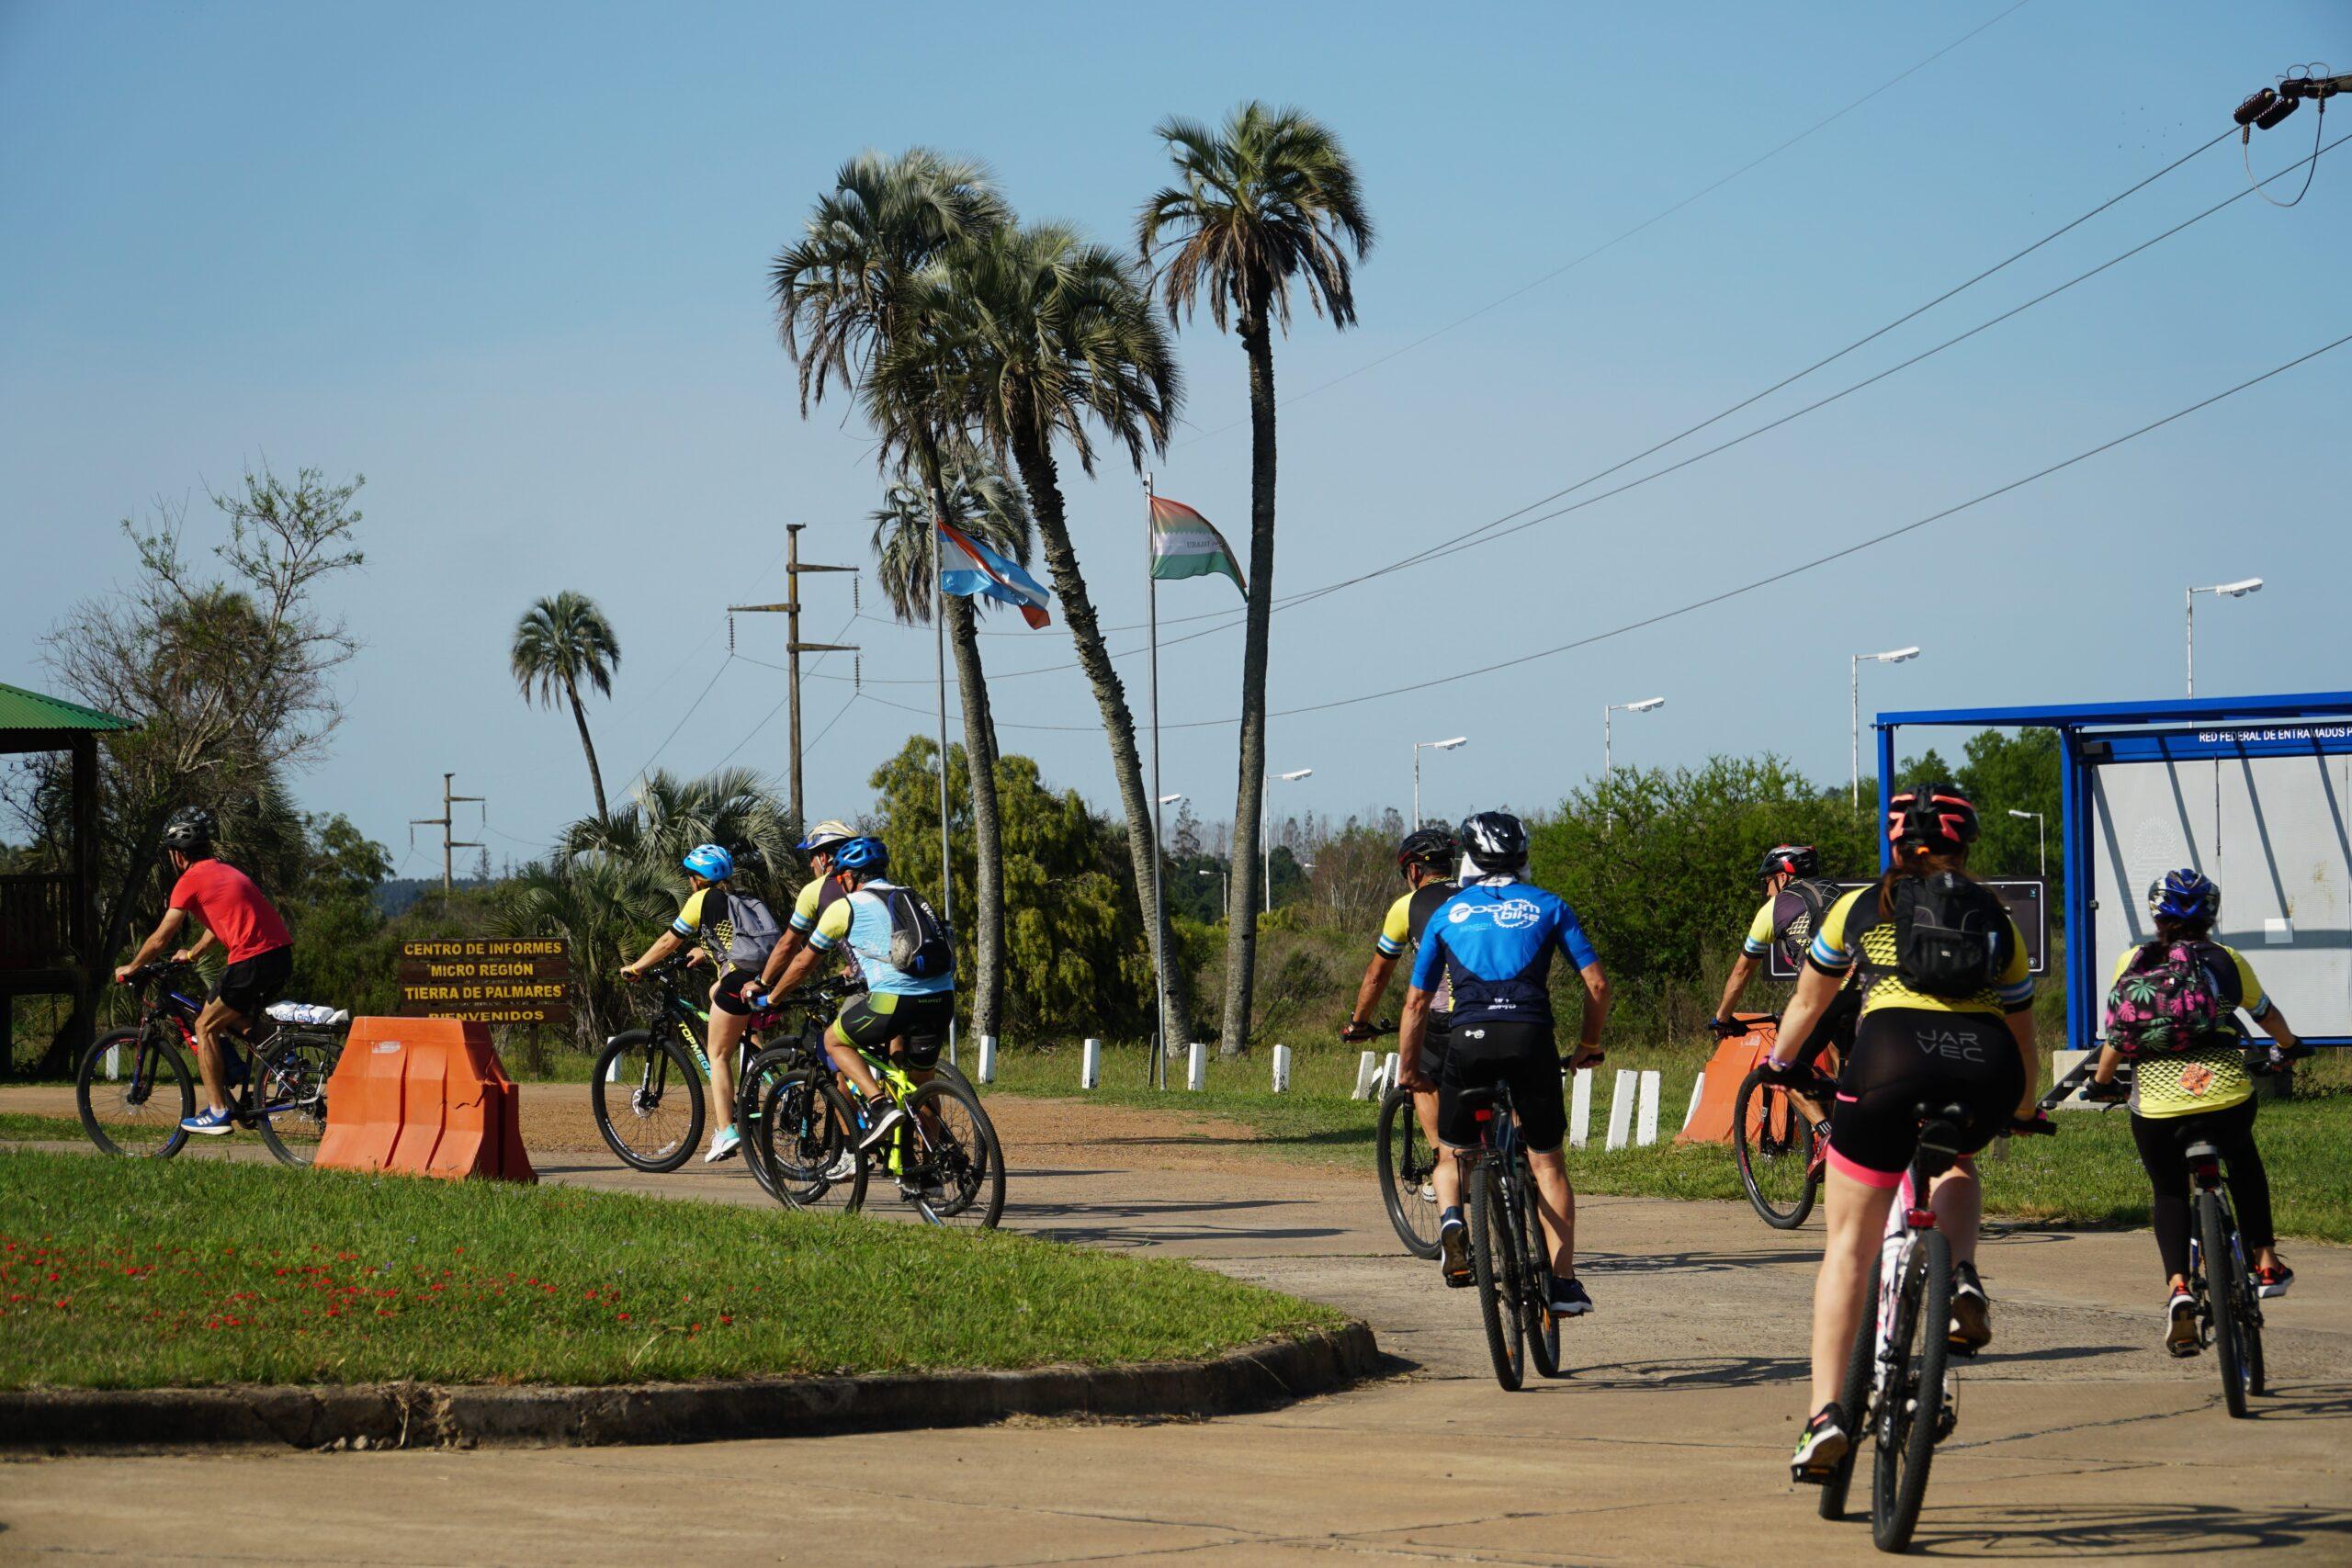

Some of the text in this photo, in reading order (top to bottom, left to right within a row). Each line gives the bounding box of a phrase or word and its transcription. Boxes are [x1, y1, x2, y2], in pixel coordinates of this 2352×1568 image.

[2199, 732, 2217, 742] RED
[2220, 730, 2261, 742] FEDERAL
[2263, 729, 2276, 740] DE
[2278, 727, 2345, 740] ENTRAMADOS
[404, 942, 562, 955] CENTRO DE INFORMES
[479, 961, 534, 976] REGIÓN
[404, 987, 459, 1000] TIERRA
[463, 986, 482, 999] DE
[1916, 1029, 1979, 1045] JAR
[1917, 1039, 1985, 1063] VEC
